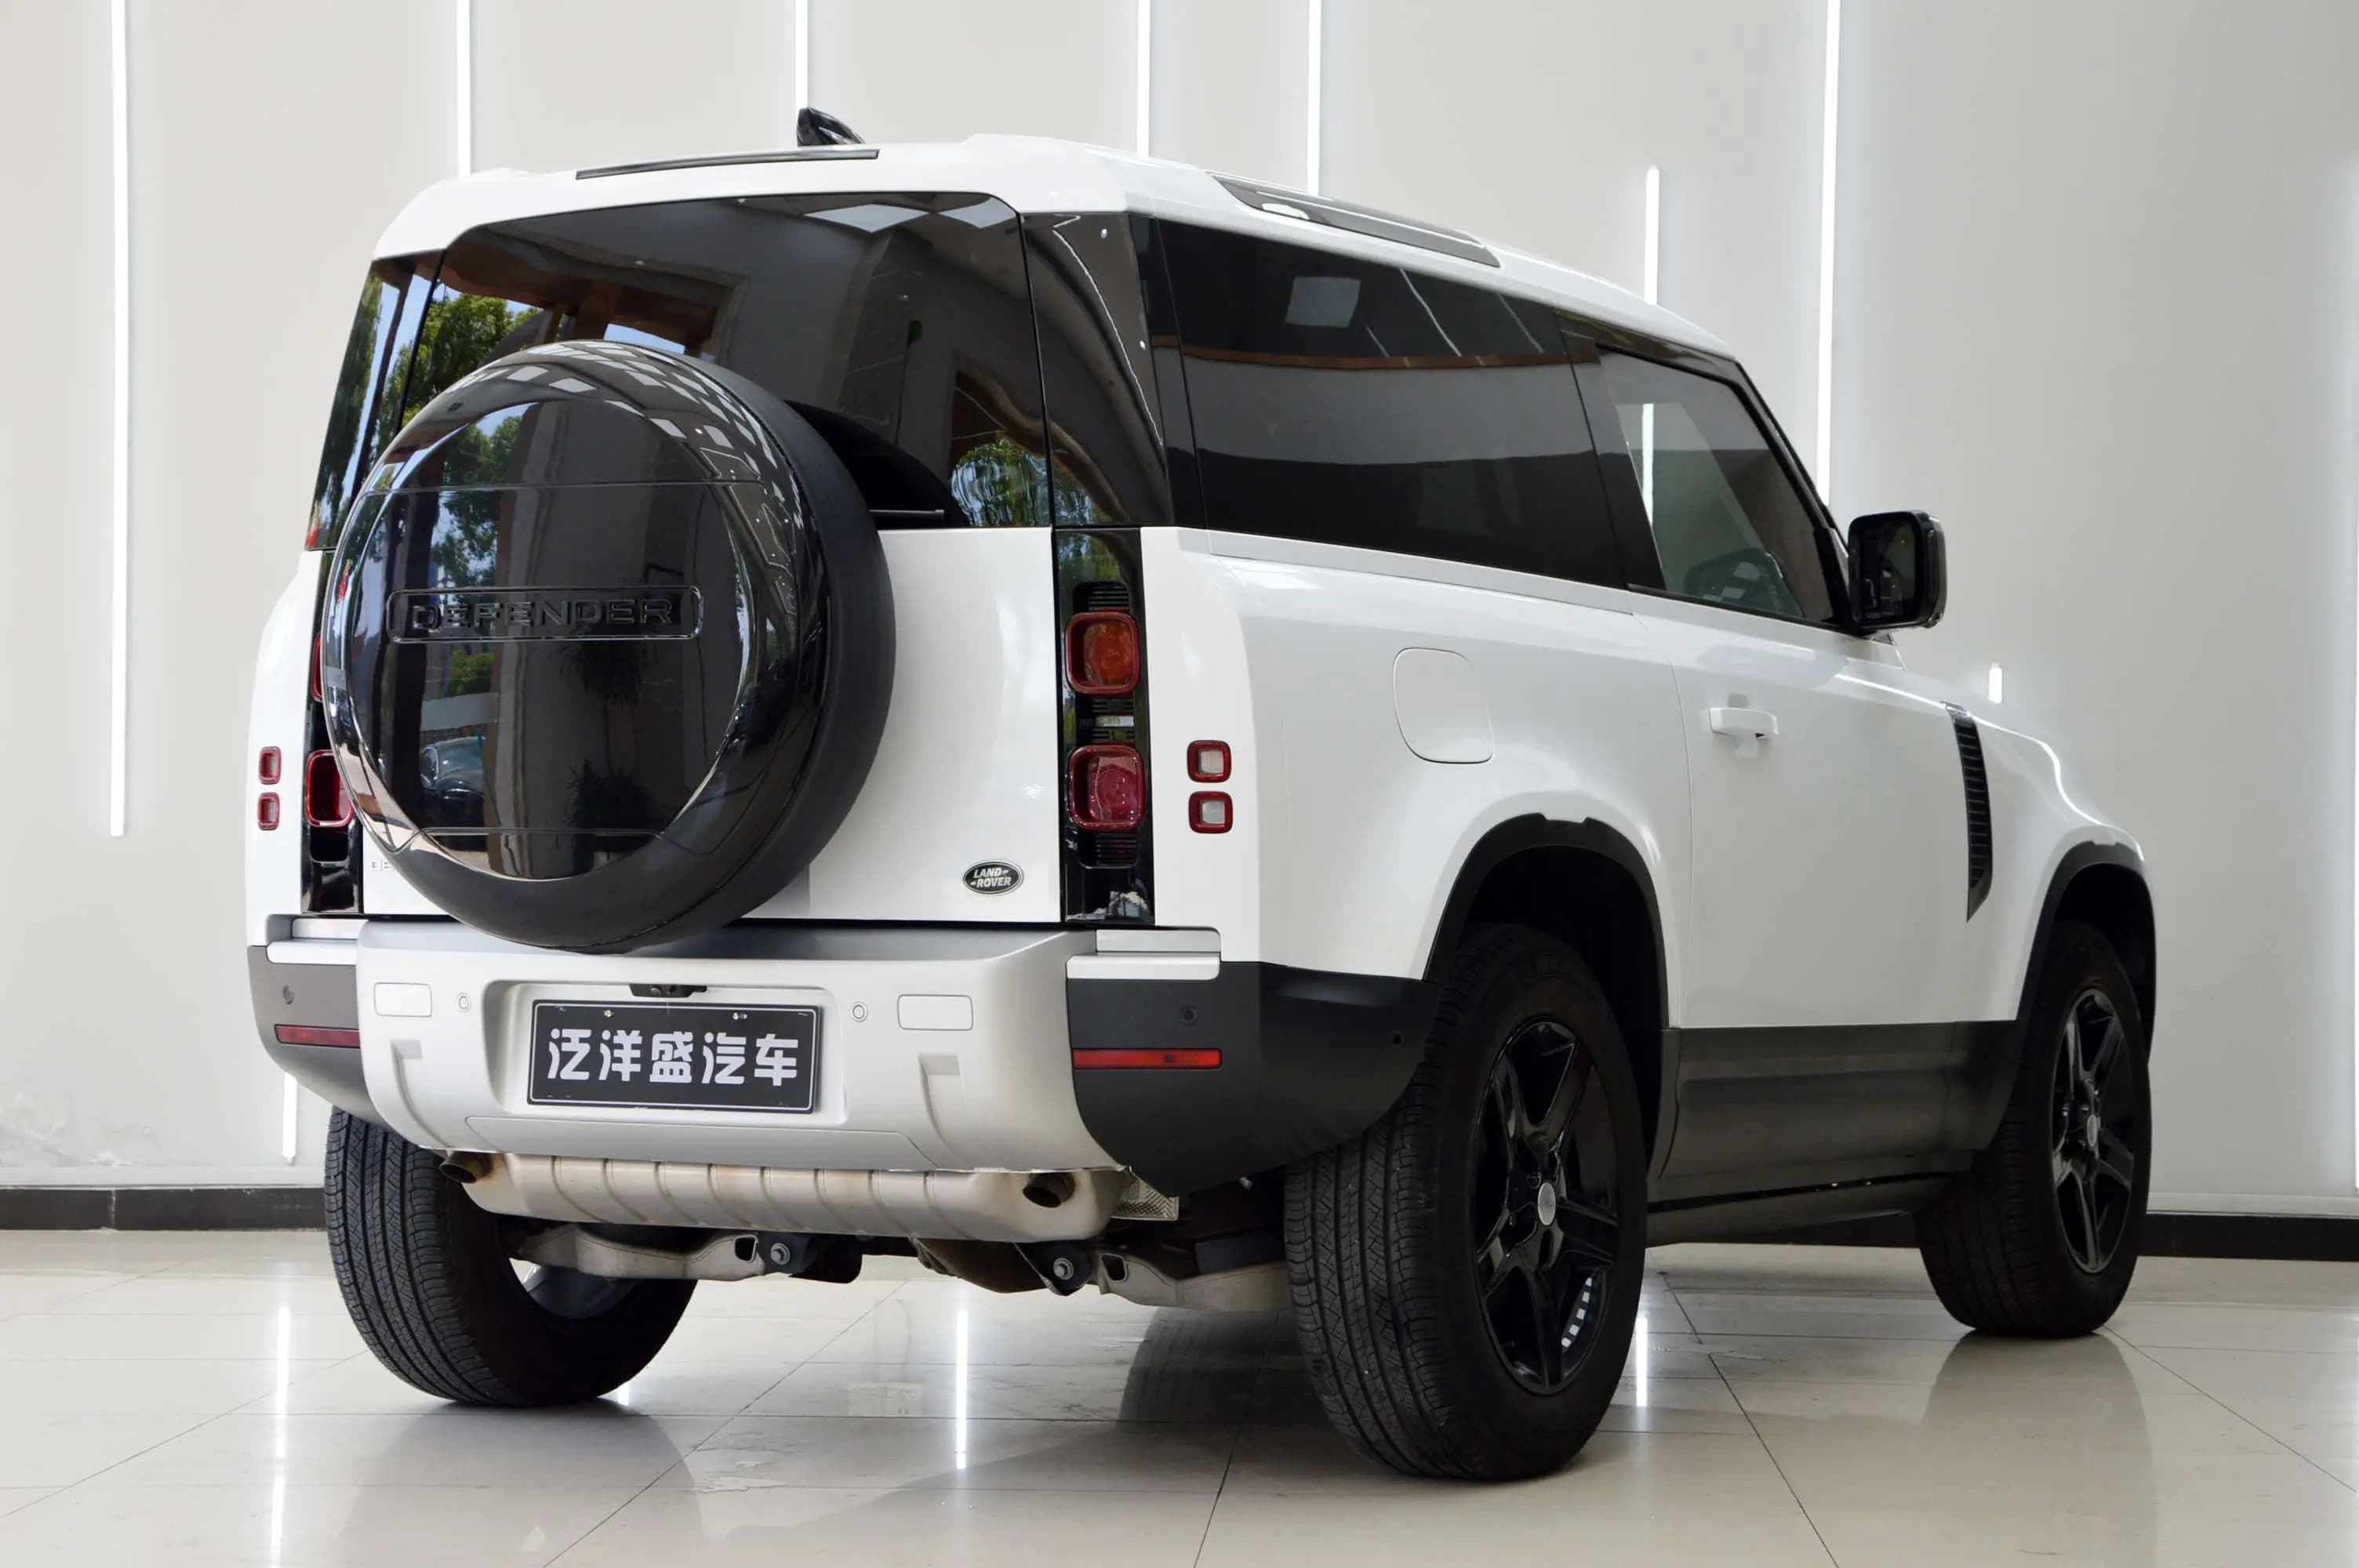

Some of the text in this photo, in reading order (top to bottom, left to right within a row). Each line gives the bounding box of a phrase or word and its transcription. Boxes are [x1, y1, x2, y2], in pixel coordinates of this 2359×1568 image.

[412, 599, 673, 630] DEFENDER
[973, 867, 1002, 878] LAND
[976, 877, 1012, 888] ROVER
[547, 1029, 798, 1087] 泛洋盛汽车
